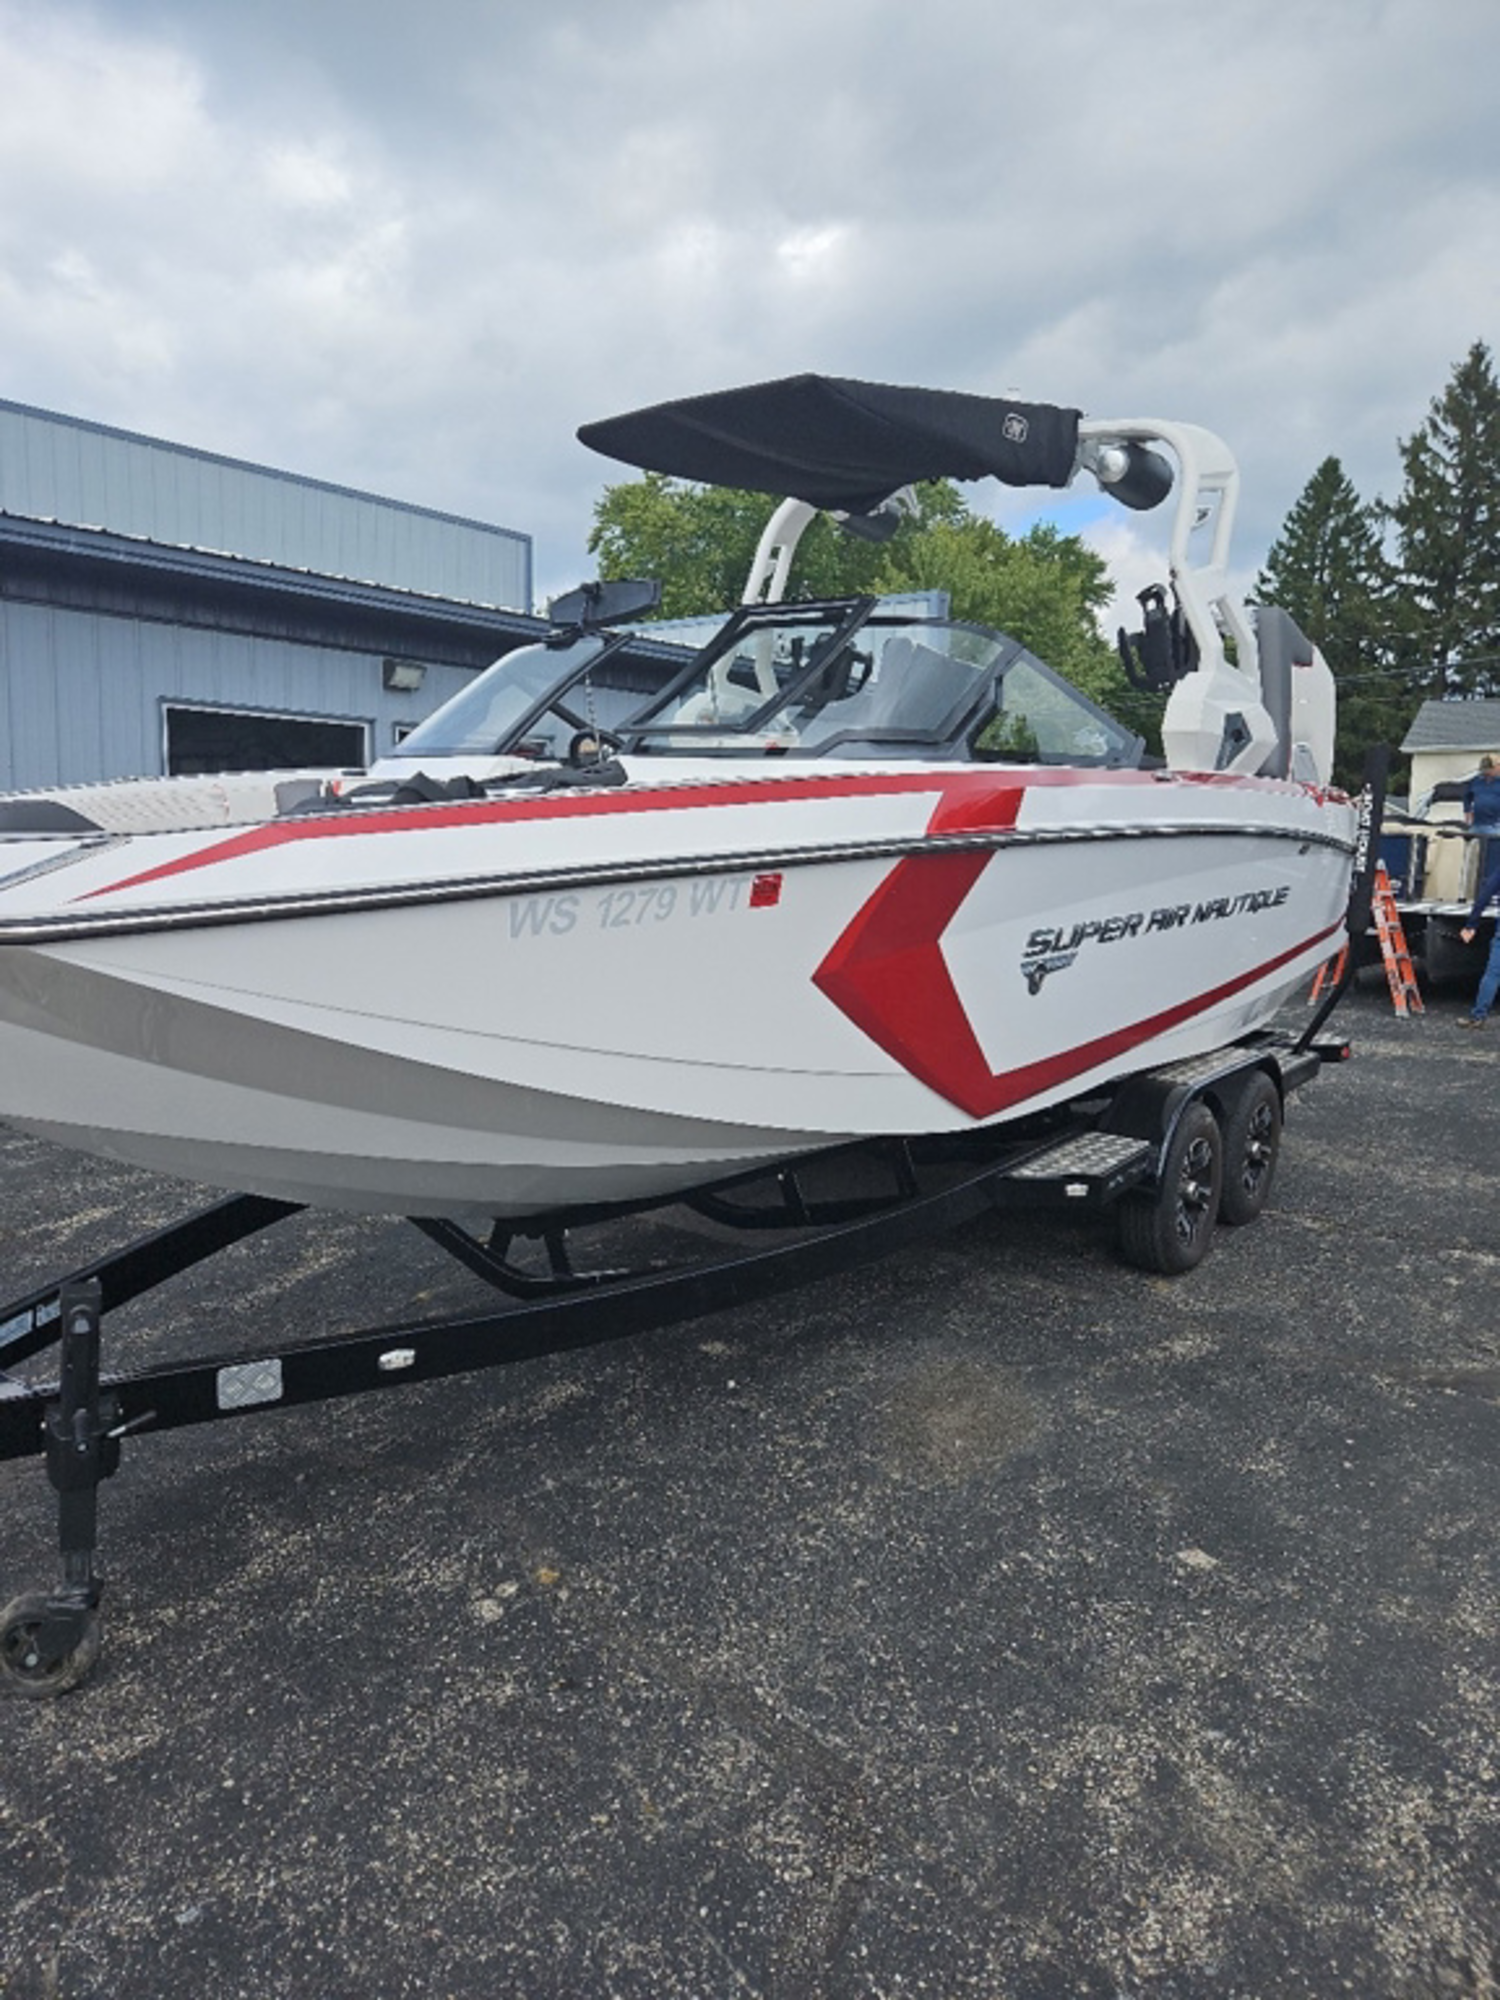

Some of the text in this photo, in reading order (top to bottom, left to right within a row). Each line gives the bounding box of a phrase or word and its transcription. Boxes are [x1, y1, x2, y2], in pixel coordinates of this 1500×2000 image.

[509, 895, 580, 939] WS
[597, 885, 678, 929] 1279
[689, 876, 750, 917] WT
[1022, 885, 1291, 958] SUPER AIR NAUTIQUE
